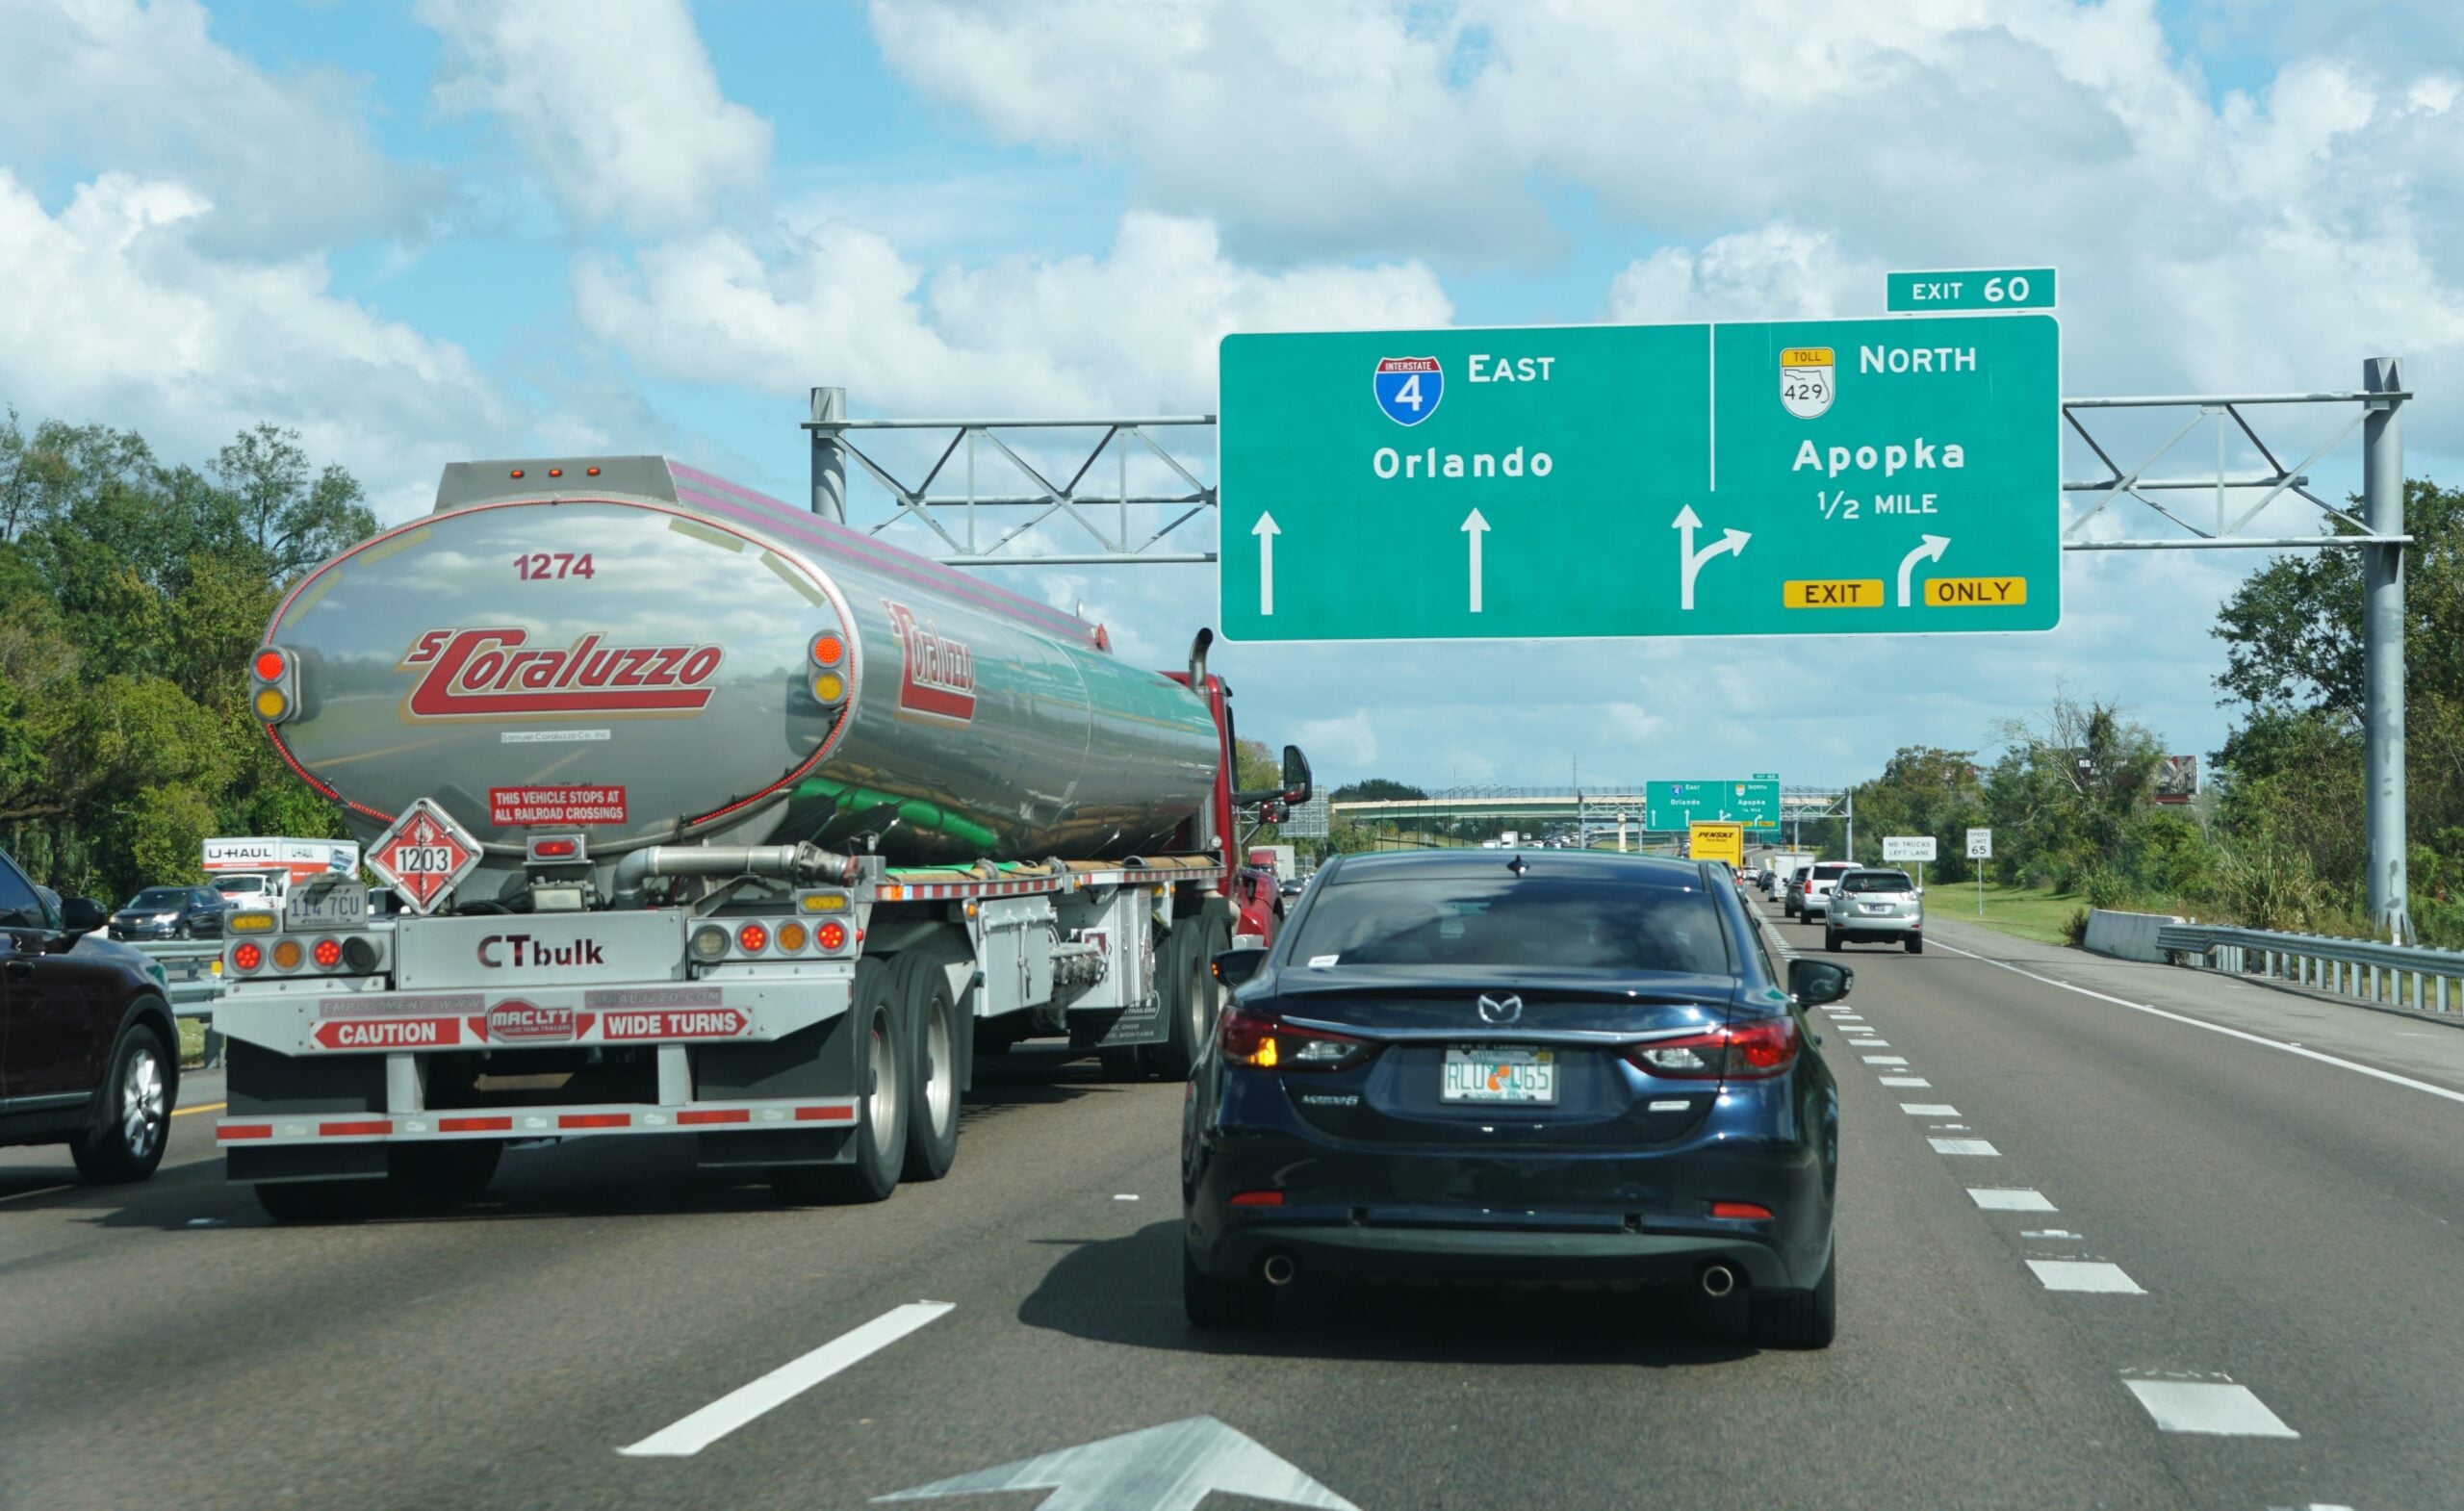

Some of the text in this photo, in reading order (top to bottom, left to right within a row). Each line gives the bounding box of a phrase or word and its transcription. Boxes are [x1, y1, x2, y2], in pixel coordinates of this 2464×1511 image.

[1912, 277, 2030, 302] EXIT 60
[1385, 361, 1432, 372] INTERSTATE
[1793, 351, 1822, 362] TOLL
[1860, 346, 1976, 374] NORTH
[1468, 354, 1555, 383] EAST
[1394, 373, 1424, 411] 4
[1784, 383, 1825, 402] 429
[1373, 447, 1554, 479] Orlando
[1792, 439, 1965, 478] Apopka
[1817, 492, 1938, 521] 1/2 MILE
[513, 552, 595, 580] 1274
[1805, 583, 1861, 604] EXIT
[1938, 580, 2013, 602] ONLY
[495, 790, 620, 805] THIS VEHICLE STOPS AT
[495, 807, 624, 821] ALL RAILROAD CROSSINGS
[398, 848, 449, 871] 1203
[1971, 845, 1987, 855] 65
[329, 895, 360, 915] 7CU
[338, 1022, 436, 1045] CAUTION
[608, 1012, 738, 1037] WIDE TURNS
